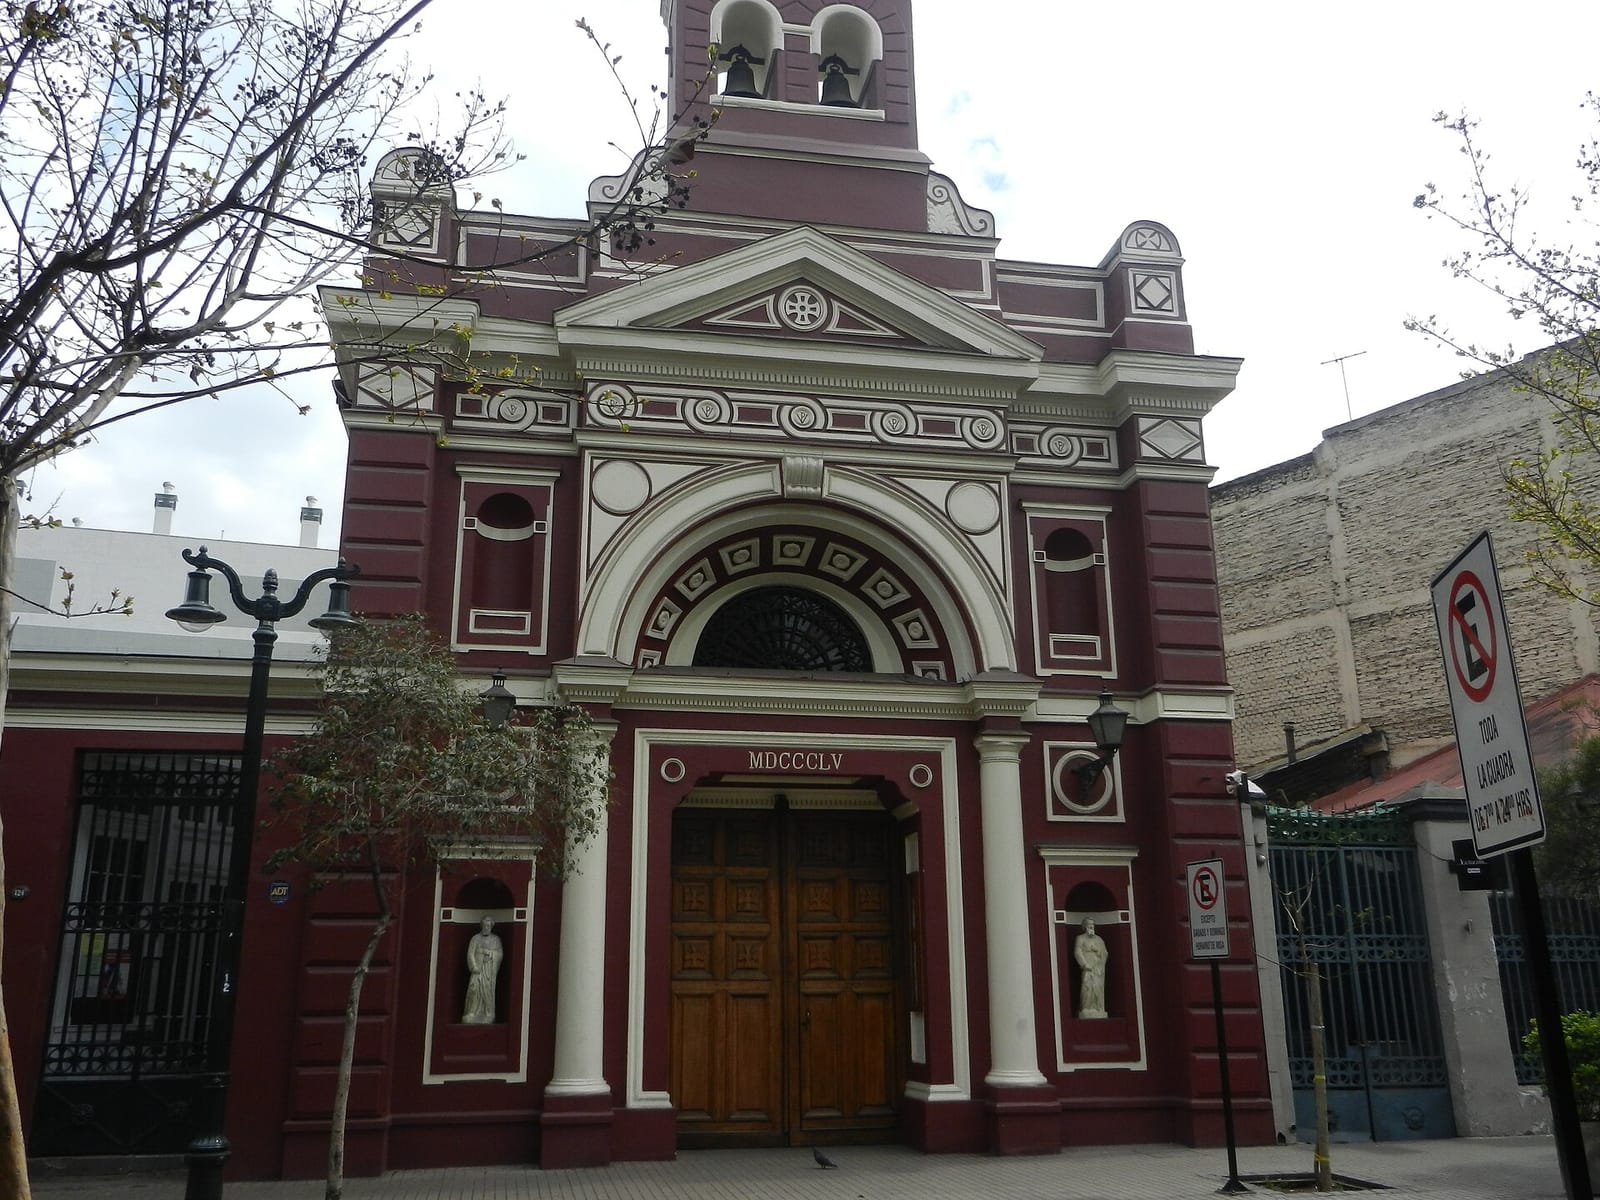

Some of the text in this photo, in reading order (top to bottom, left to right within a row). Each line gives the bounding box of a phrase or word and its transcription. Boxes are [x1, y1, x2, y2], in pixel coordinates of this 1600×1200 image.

[1478, 714, 1499, 745] TODA
[748, 751, 843, 771] MDCCCLV
[1476, 750, 1515, 789] LA CUADRA
[1515, 788, 1533, 818] HRS
[271, 887, 289, 896] ADT
